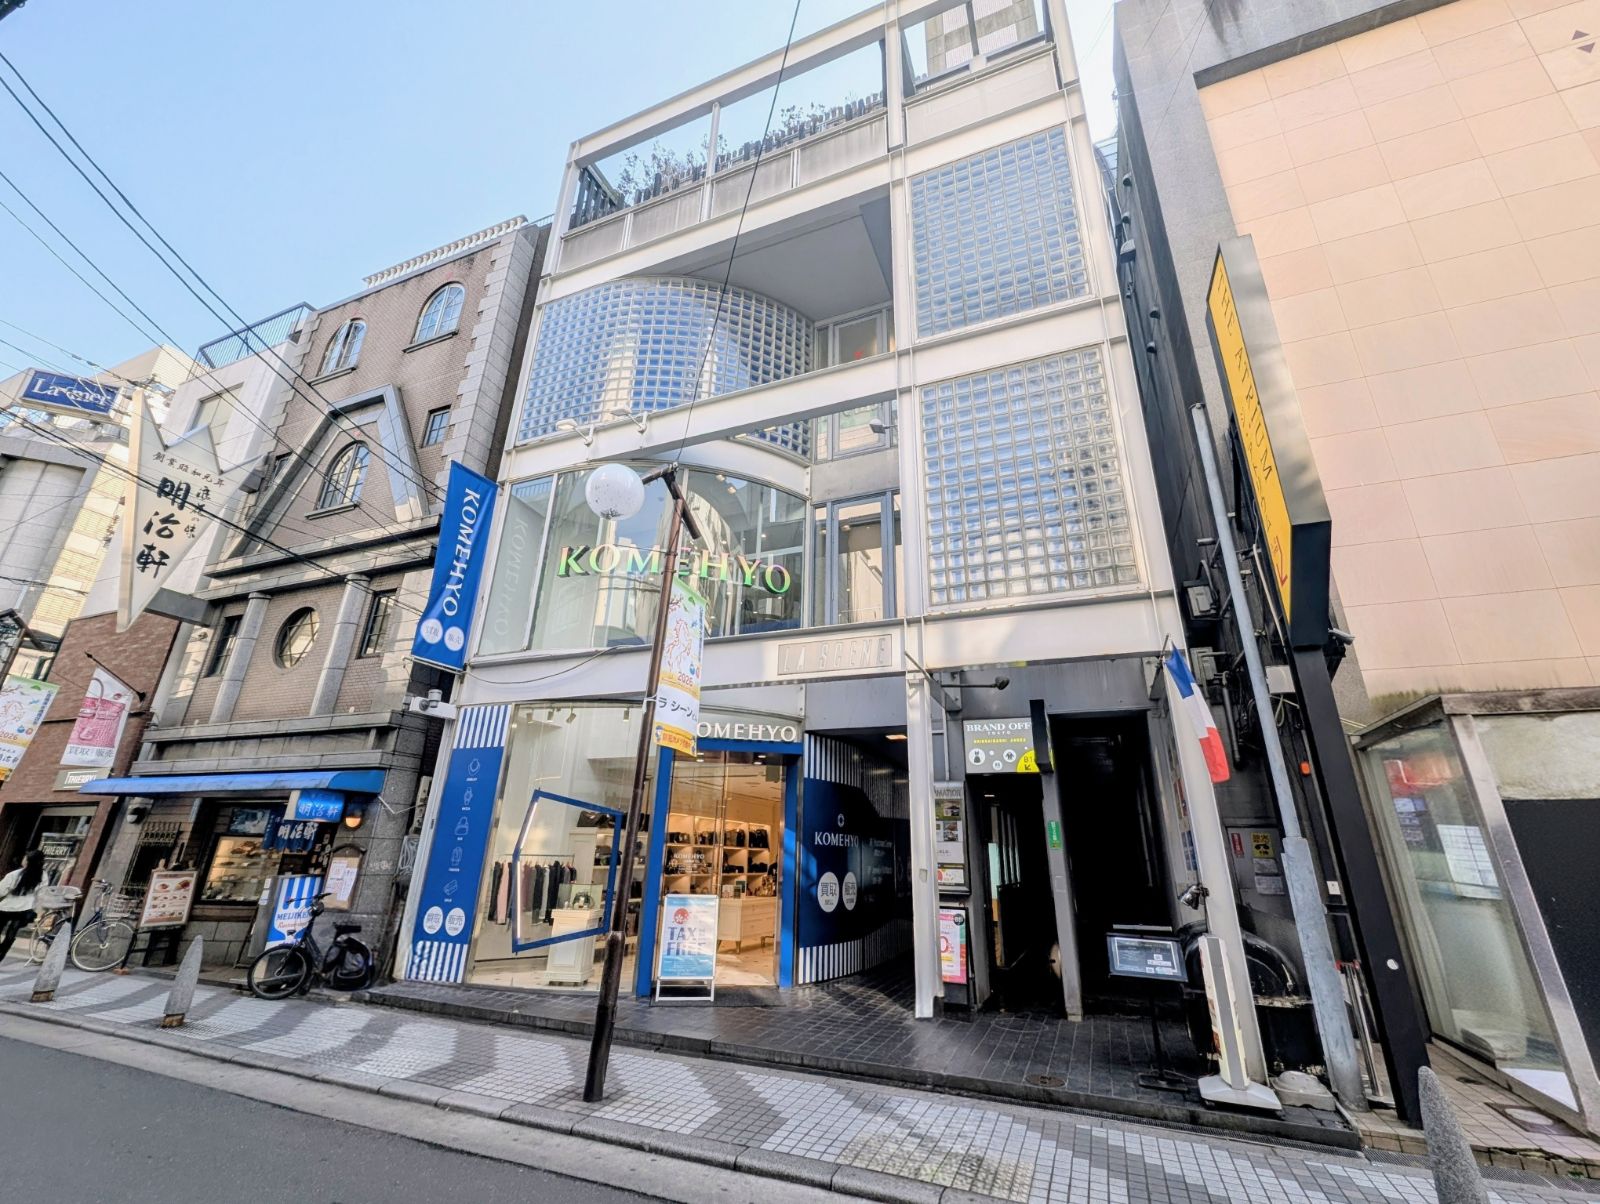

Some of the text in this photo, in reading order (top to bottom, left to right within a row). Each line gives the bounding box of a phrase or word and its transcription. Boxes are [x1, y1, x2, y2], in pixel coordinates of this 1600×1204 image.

[1217, 266, 1235, 336] THE
[136, 477, 191, 579] 明治軒
[443, 488, 480, 616] KOMEHYO
[558, 543, 792, 594] KOMEHYO
[784, 638, 886, 673] LA SCENE
[677, 671, 694, 687] 2026
[696, 721, 797, 742] OMEHYO
[966, 722, 1032, 732] BRAND OFF
[298, 803, 339, 817] 明治軒
[814, 832, 859, 848] KOMEHYO
[820, 882, 837, 897] 買取
[668, 927, 697, 940] TAX
